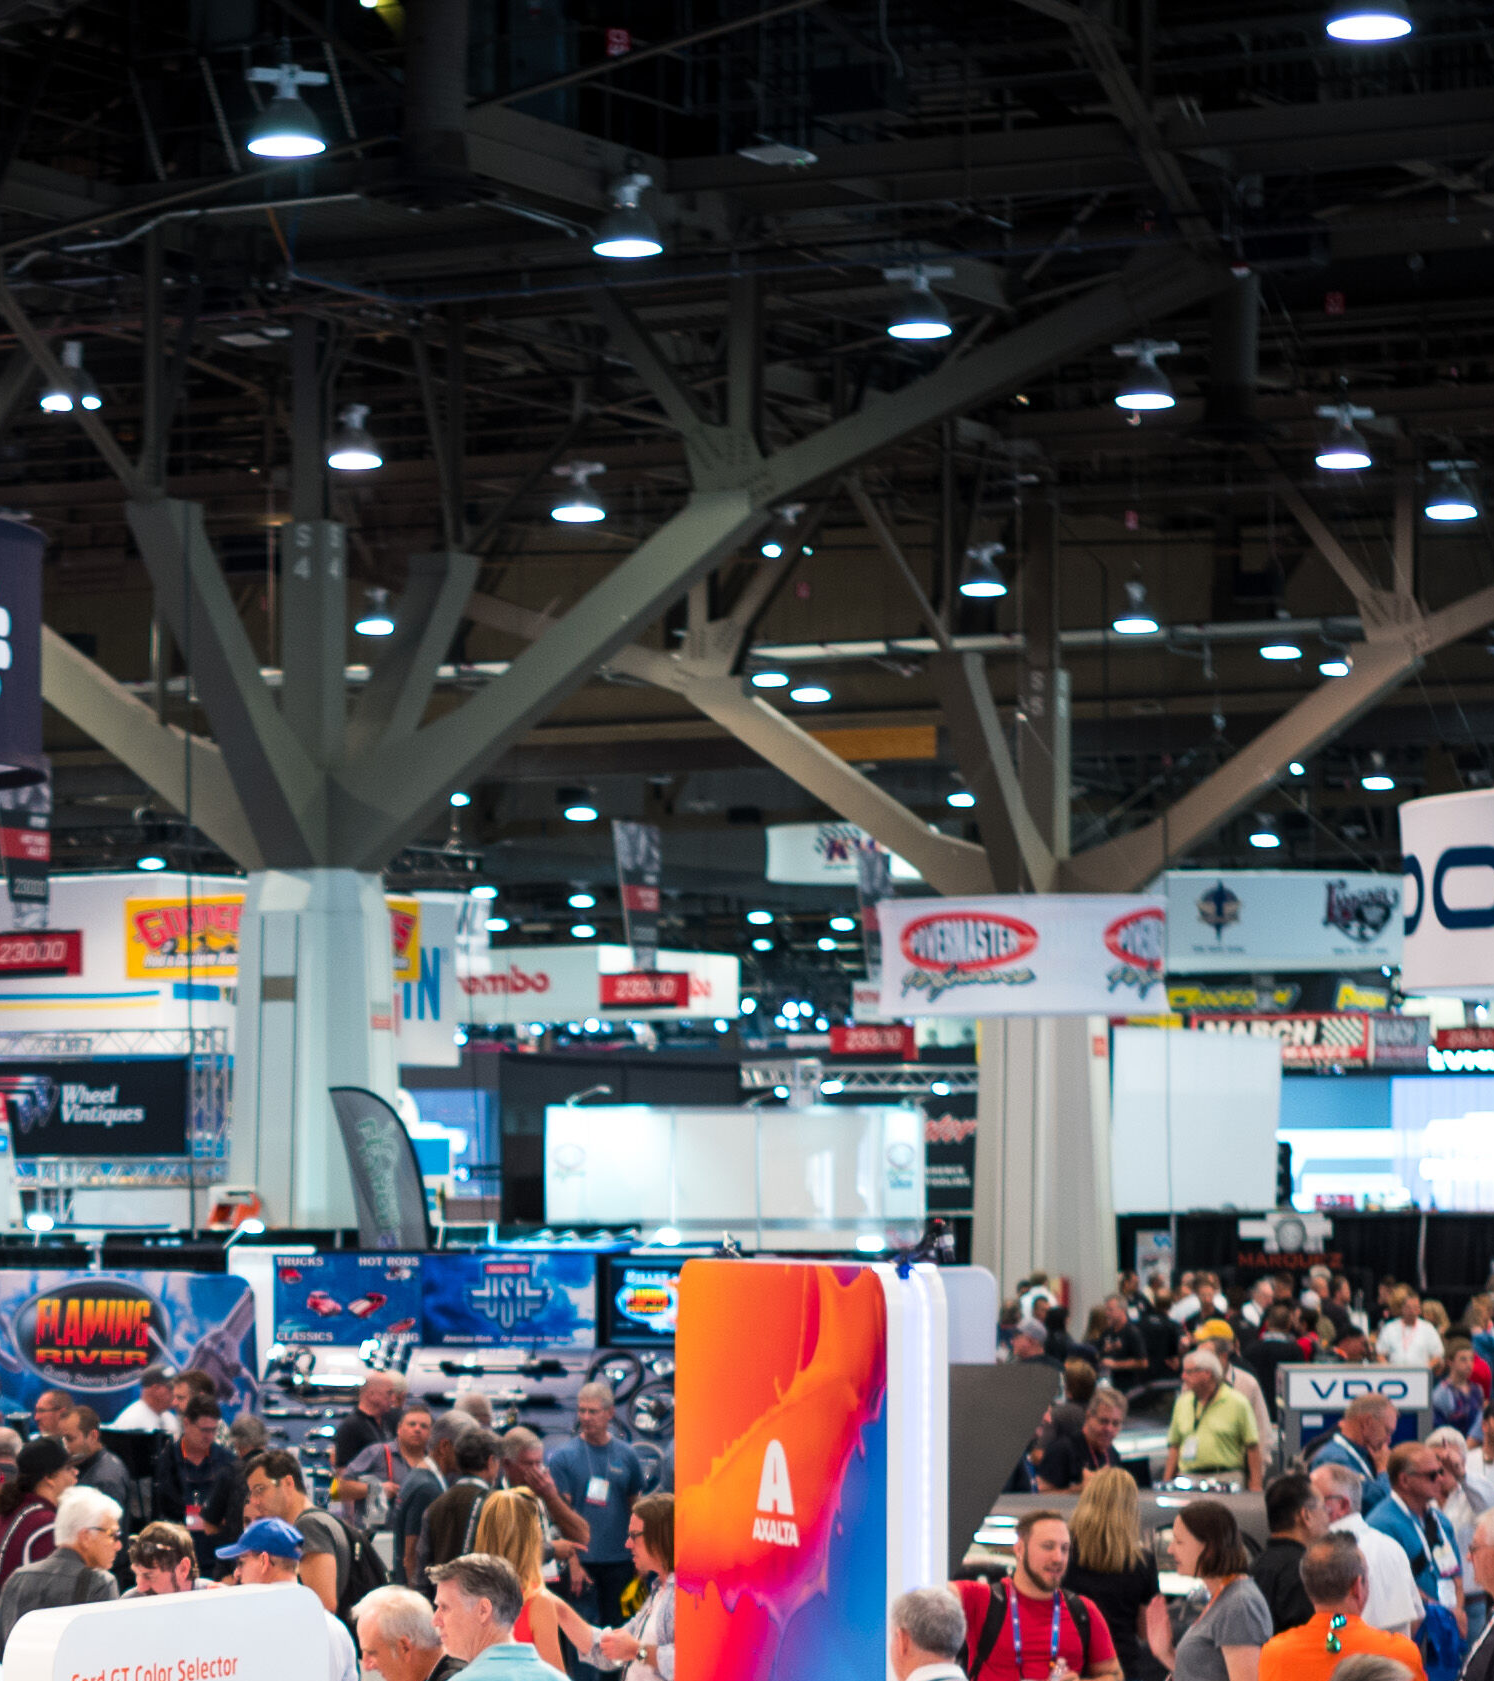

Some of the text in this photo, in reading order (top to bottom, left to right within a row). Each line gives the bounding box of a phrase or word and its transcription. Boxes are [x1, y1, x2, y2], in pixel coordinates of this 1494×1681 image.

[61, 1083, 119, 1106] Wheel
[60, 1102, 145, 1124] Vintiques
[276, 1256, 324, 1267] TRUCKS
[358, 1256, 420, 1267] HOT RODS
[35, 1296, 152, 1349] FLAMING
[276, 1331, 334, 1342] CLASSICS
[34, 1348, 149, 1365] RIVER
[1310, 1378, 1410, 1400] VDO
[752, 1516, 799, 1549] AXALTA
